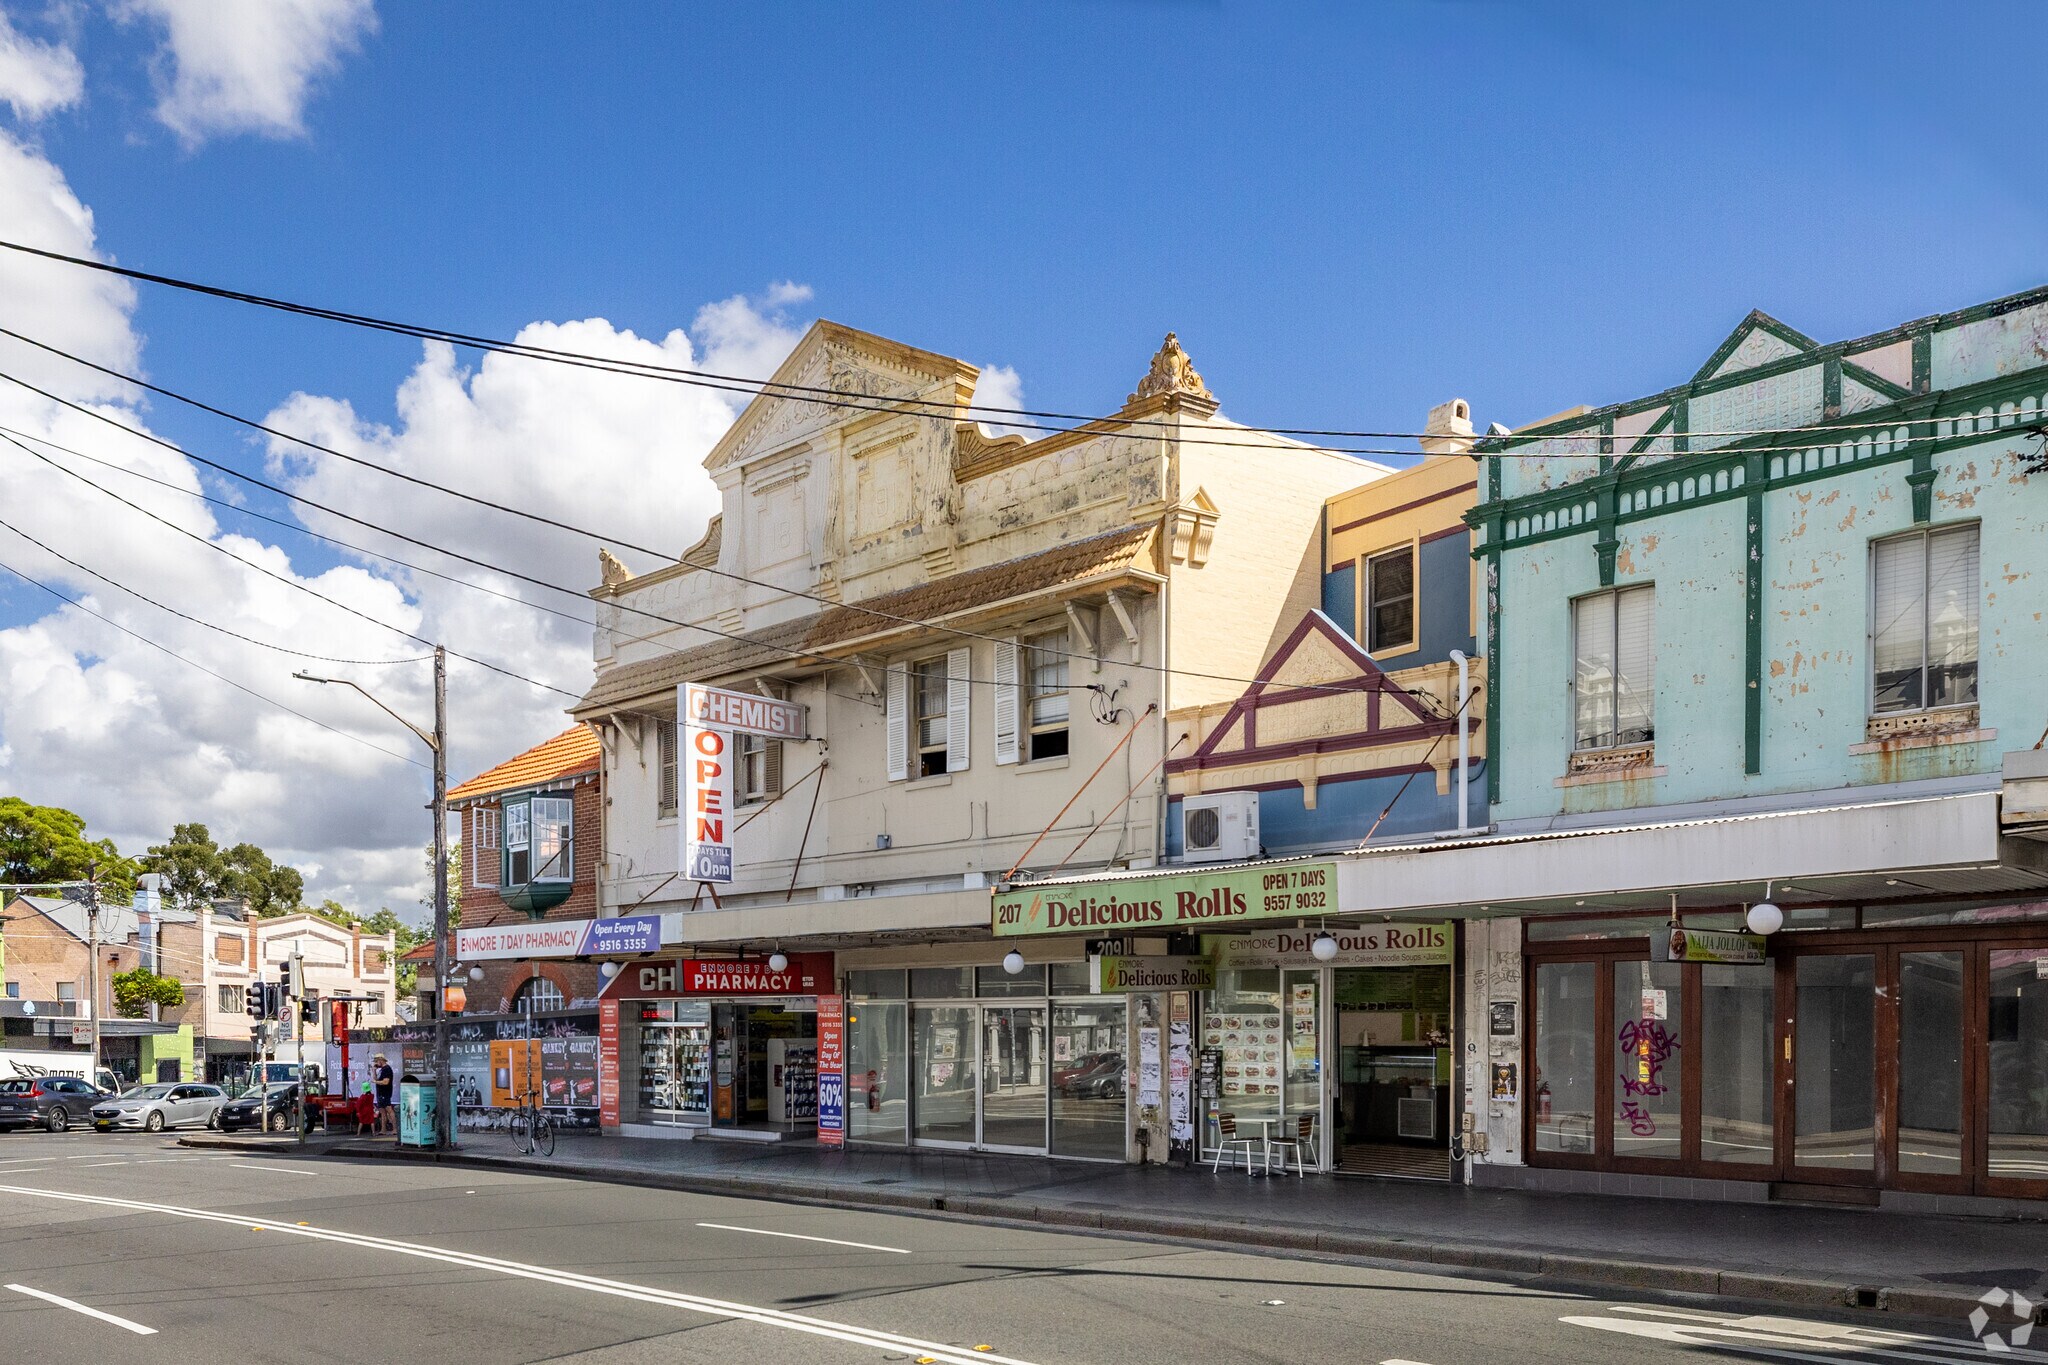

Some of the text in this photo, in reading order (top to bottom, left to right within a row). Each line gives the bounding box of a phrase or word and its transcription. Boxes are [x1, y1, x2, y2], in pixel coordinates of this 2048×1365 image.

[692, 690, 798, 733] CHEMIST
[695, 731, 724, 844] OPEN
[697, 847, 714, 857] DAYS
[715, 848, 729, 857] TILL
[1263, 869, 1325, 891] OPEN 7 DAYS
[1045, 892, 1072, 901] ENMORE
[1264, 891, 1326, 912] 9557 9032
[999, 903, 1022, 924] 207
[1046, 887, 1247, 928] Delicious Rolls
[594, 920, 652, 937] Open Every Day
[461, 930, 577, 953] ENMORE 7 DAY PHARMACY
[600, 938, 647, 950] 9516 3355
[1097, 940, 1122, 956] 209
[1229, 927, 1445, 953] ENMORE Delious Rolls
[1688, 932, 1714, 950] NAIJA
[1716, 936, 1746, 951] JOLLOF
[1118, 959, 1144, 968] ENMORE
[1354, 954, 1373, 963] Cakes
[1378, 954, 1400, 962] Noodle
[1401, 953, 1421, 963] Soups
[1426, 953, 1447, 961] Juices
[700, 963, 750, 974] ENMORE
[754, 964, 760, 974] 7
[694, 974, 792, 990] PHARMACY
[1118, 968, 1212, 987] Delicious Rolls
[824, 1031, 838, 1041] Open
[464, 1044, 489, 1053] LANY
[542, 1042, 565, 1054] BANKSY
[570, 1042, 594, 1054] BANKSY
[822, 1041, 838, 1050] Every
[821, 1051, 841, 1060] Day Of
[819, 1060, 843, 1069] The Year
[820, 1083, 842, 1107] 60%
